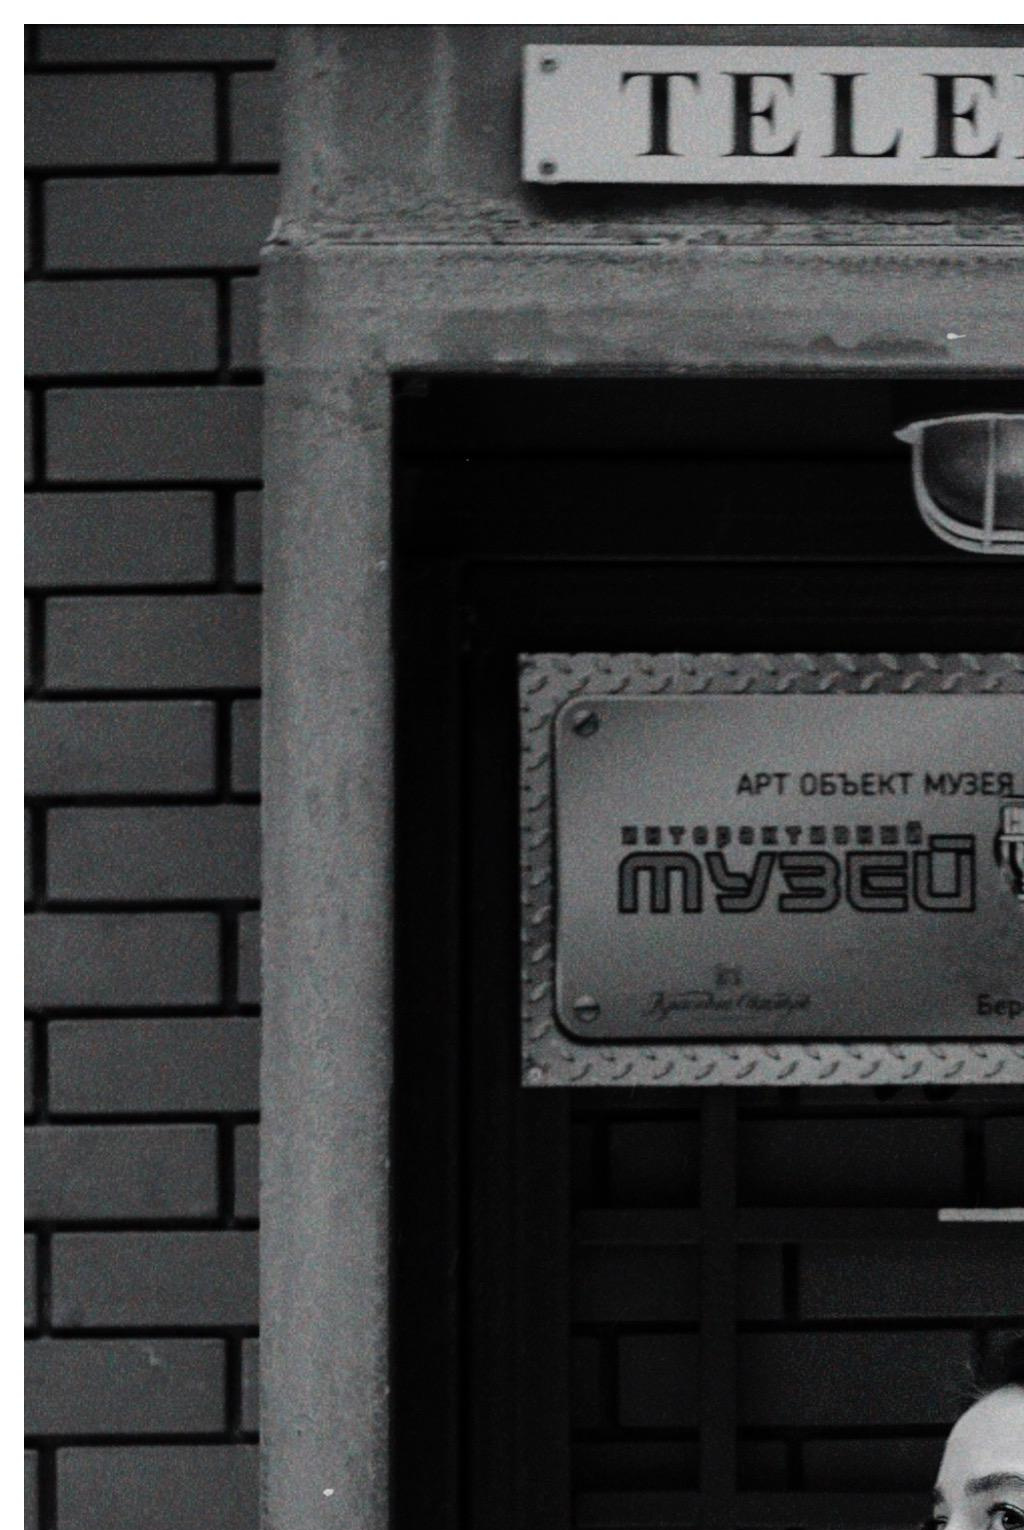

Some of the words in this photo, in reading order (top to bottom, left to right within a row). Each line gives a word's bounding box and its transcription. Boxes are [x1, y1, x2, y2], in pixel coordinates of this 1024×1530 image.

[736, 772, 788, 797] АРТ
[799, 772, 912, 797] ОБЪЕКТ
[923, 772, 1014, 797] МУЗЕЯ
